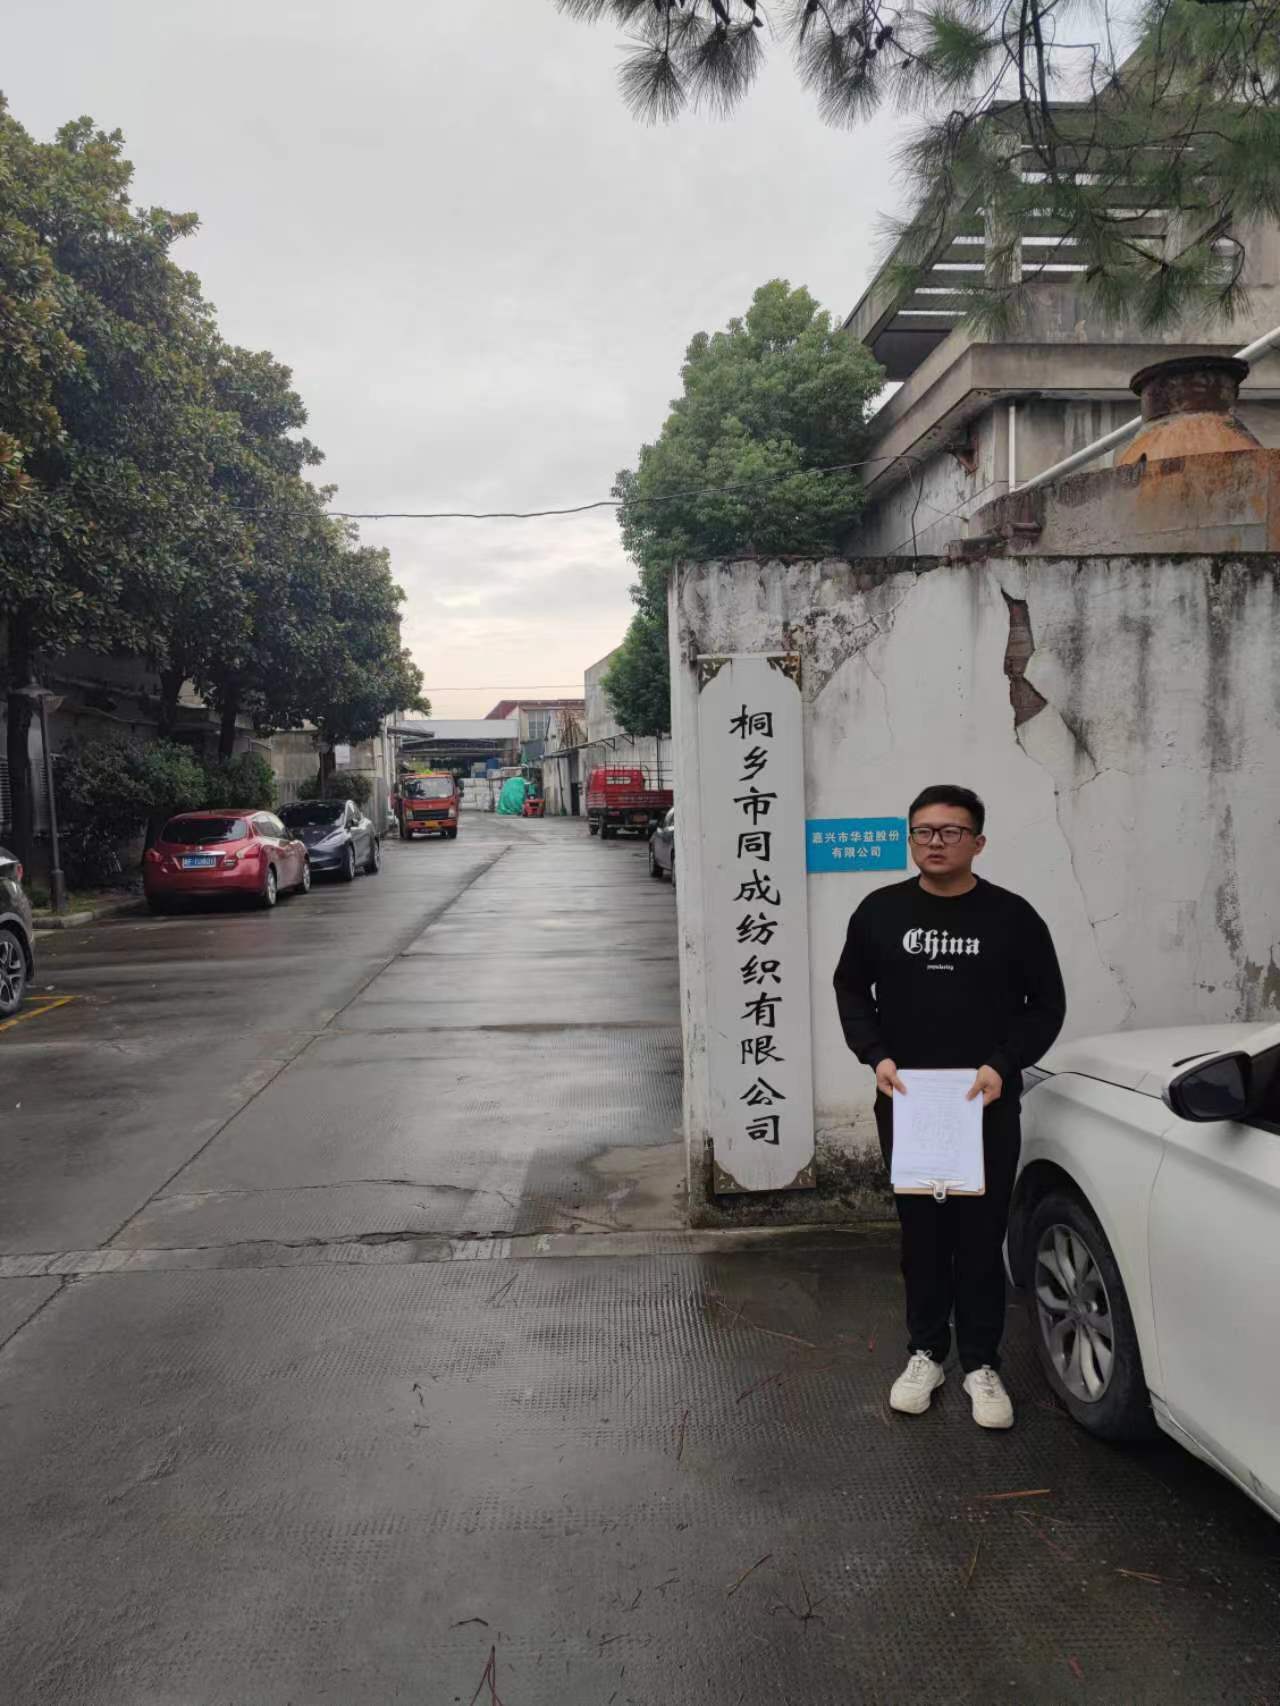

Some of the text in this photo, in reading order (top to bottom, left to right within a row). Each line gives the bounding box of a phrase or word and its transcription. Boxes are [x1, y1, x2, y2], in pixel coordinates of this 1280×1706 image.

[812, 830, 899, 843] 嘉兴市华益股份
[832, 846, 881, 859] 有限公司
[729, 704, 786, 1145] 桐乡市同成纺织有限公司
[902, 928, 980, 960] China
